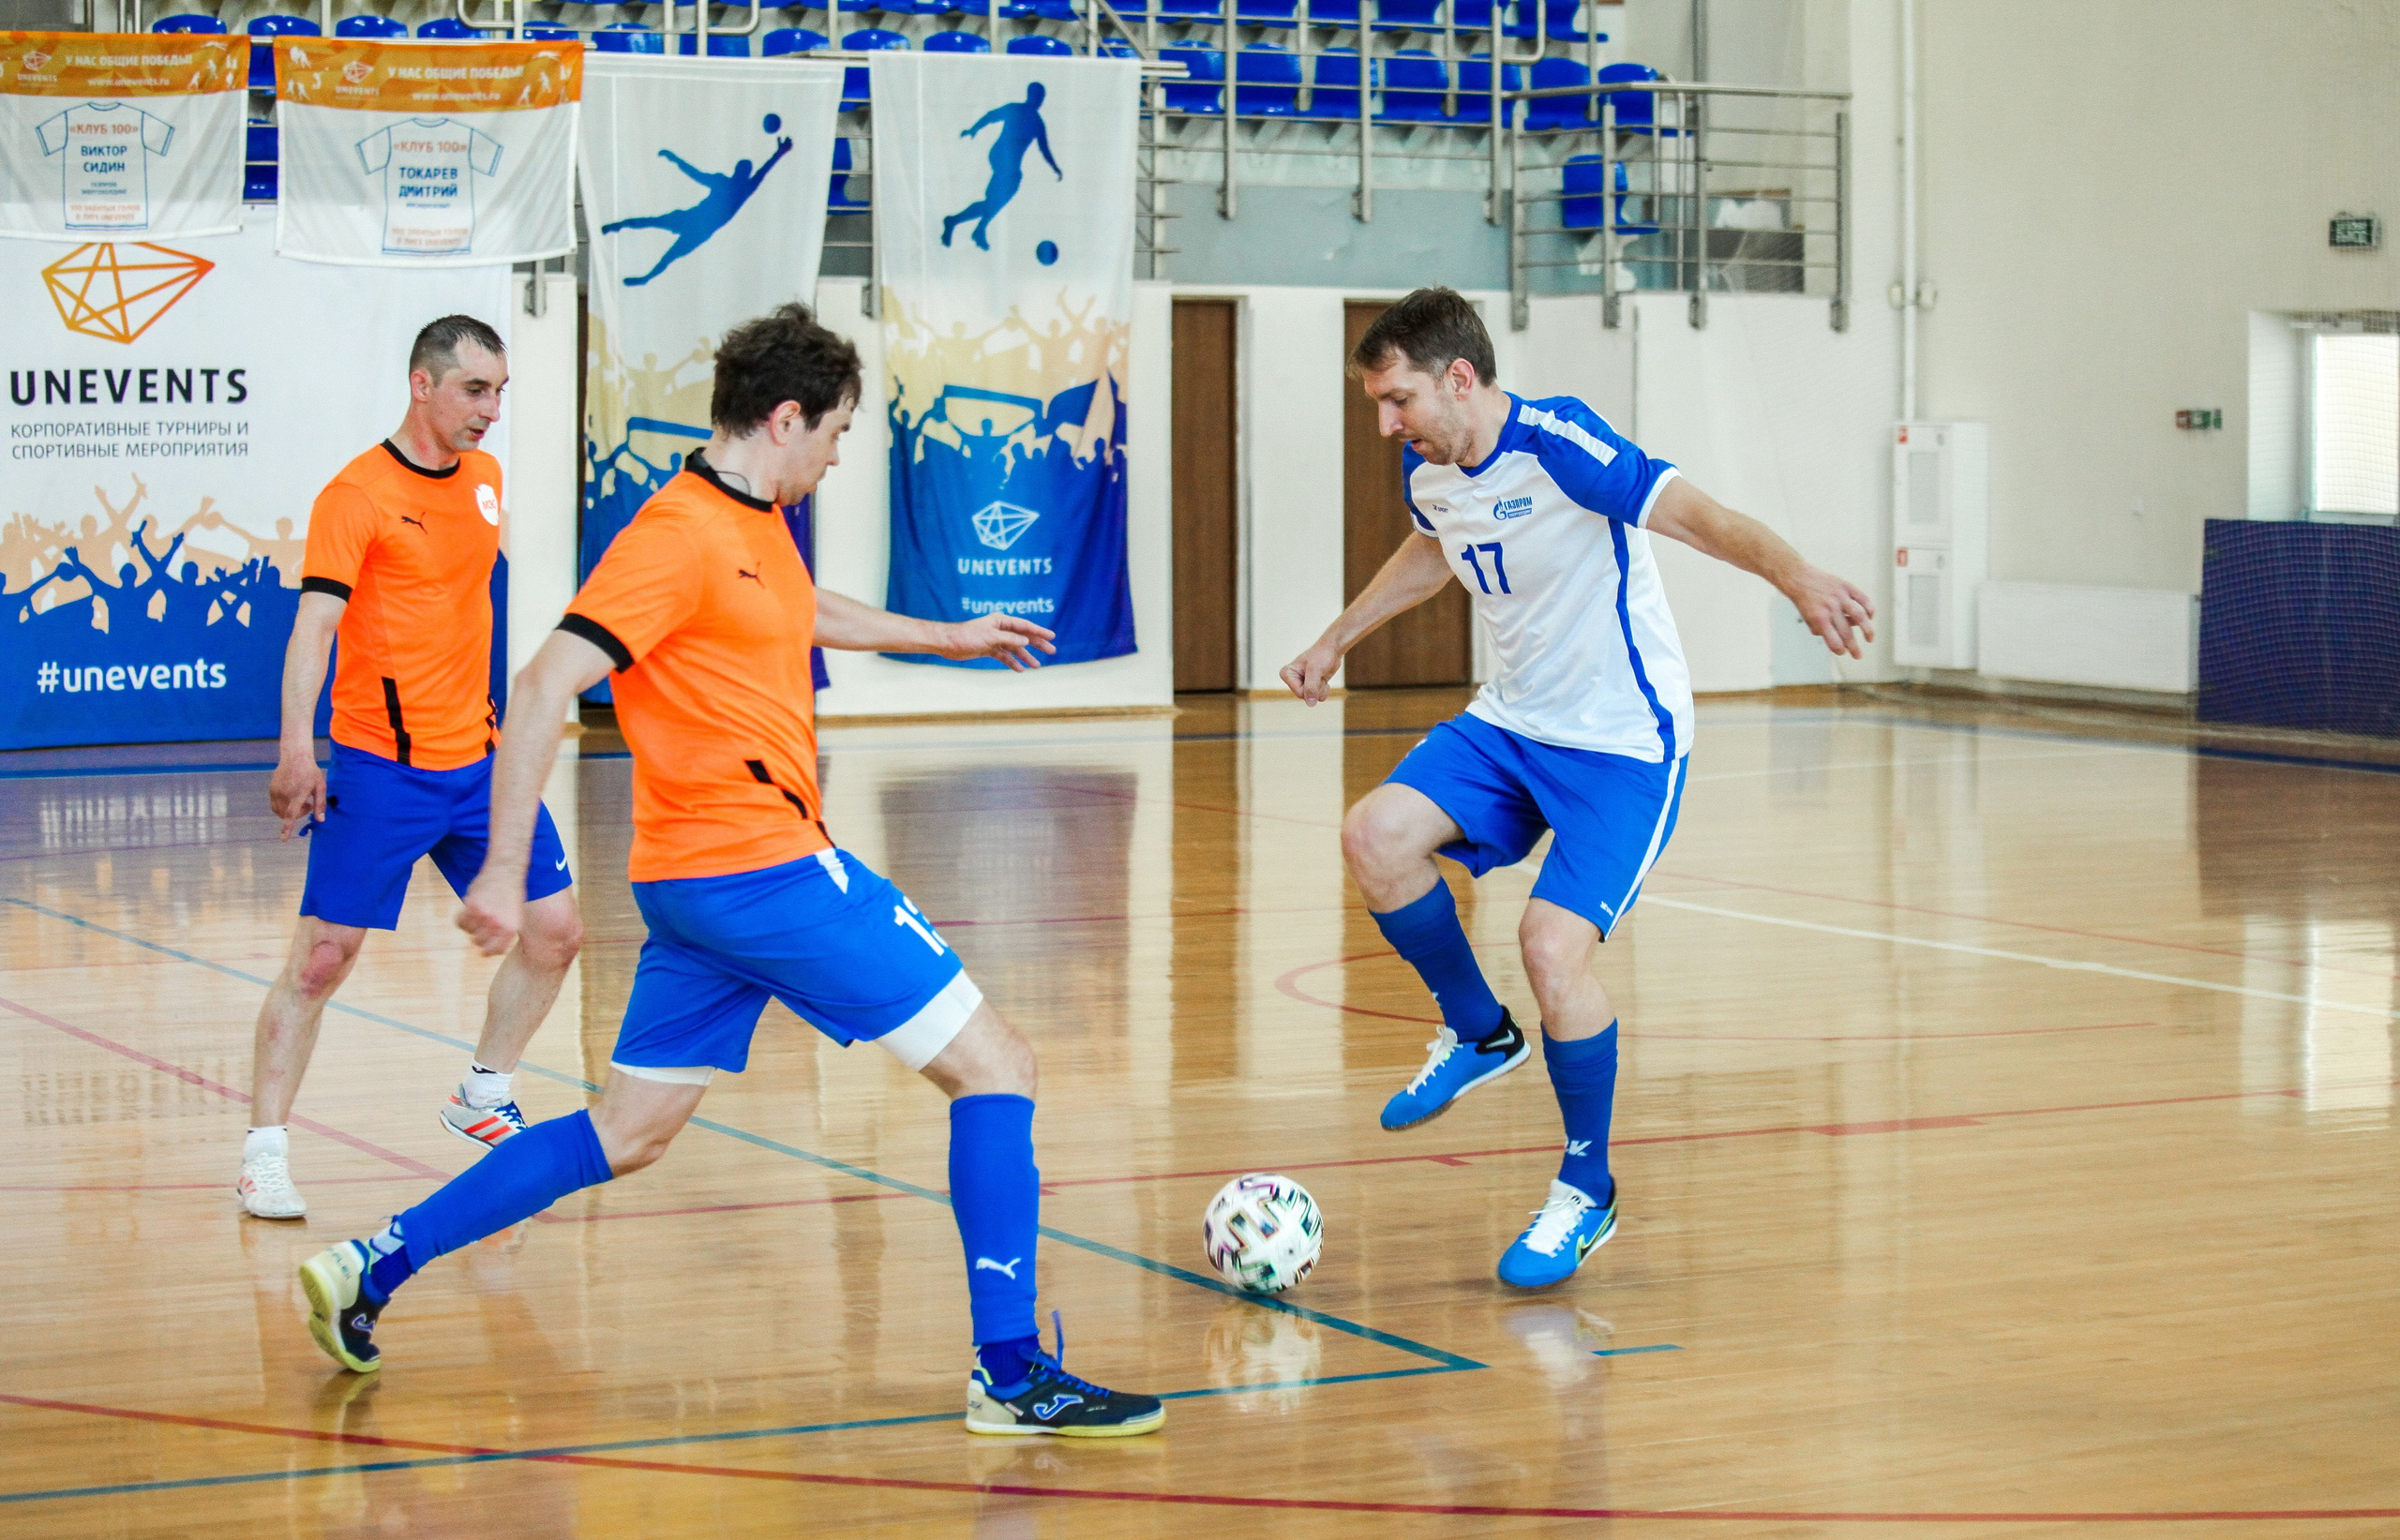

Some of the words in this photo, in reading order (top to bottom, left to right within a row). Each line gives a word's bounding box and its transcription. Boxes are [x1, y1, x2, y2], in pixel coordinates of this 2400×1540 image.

[112, 124, 139, 134] 100»
[81, 145, 128, 157] ВИКТОР
[438, 142, 467, 153] 100»
[83, 162, 125, 173] СИДИН
[399, 167, 458, 179] ТОКАРЕВ
[398, 184, 458, 198] ДМИТРИЙ
[10, 368, 248, 405] UNEVENTS
[11, 423, 150, 438] КОРПОРАТИВНЫЕ
[158, 422, 232, 436] ТУРНИРЫ
[237, 422, 248, 435] И
[12, 443, 119, 459] СПОРТИВНЫЕ
[126, 442, 248, 457] МЕРОПРИЯТИЯ
[1504, 497, 1532, 511] ГАЗПРОМ
[957, 558, 1052, 576] UNEVENTS
[1461, 542, 1512, 594] 17
[961, 597, 1055, 614] #unevents
[37, 658, 227, 693] #unevents
